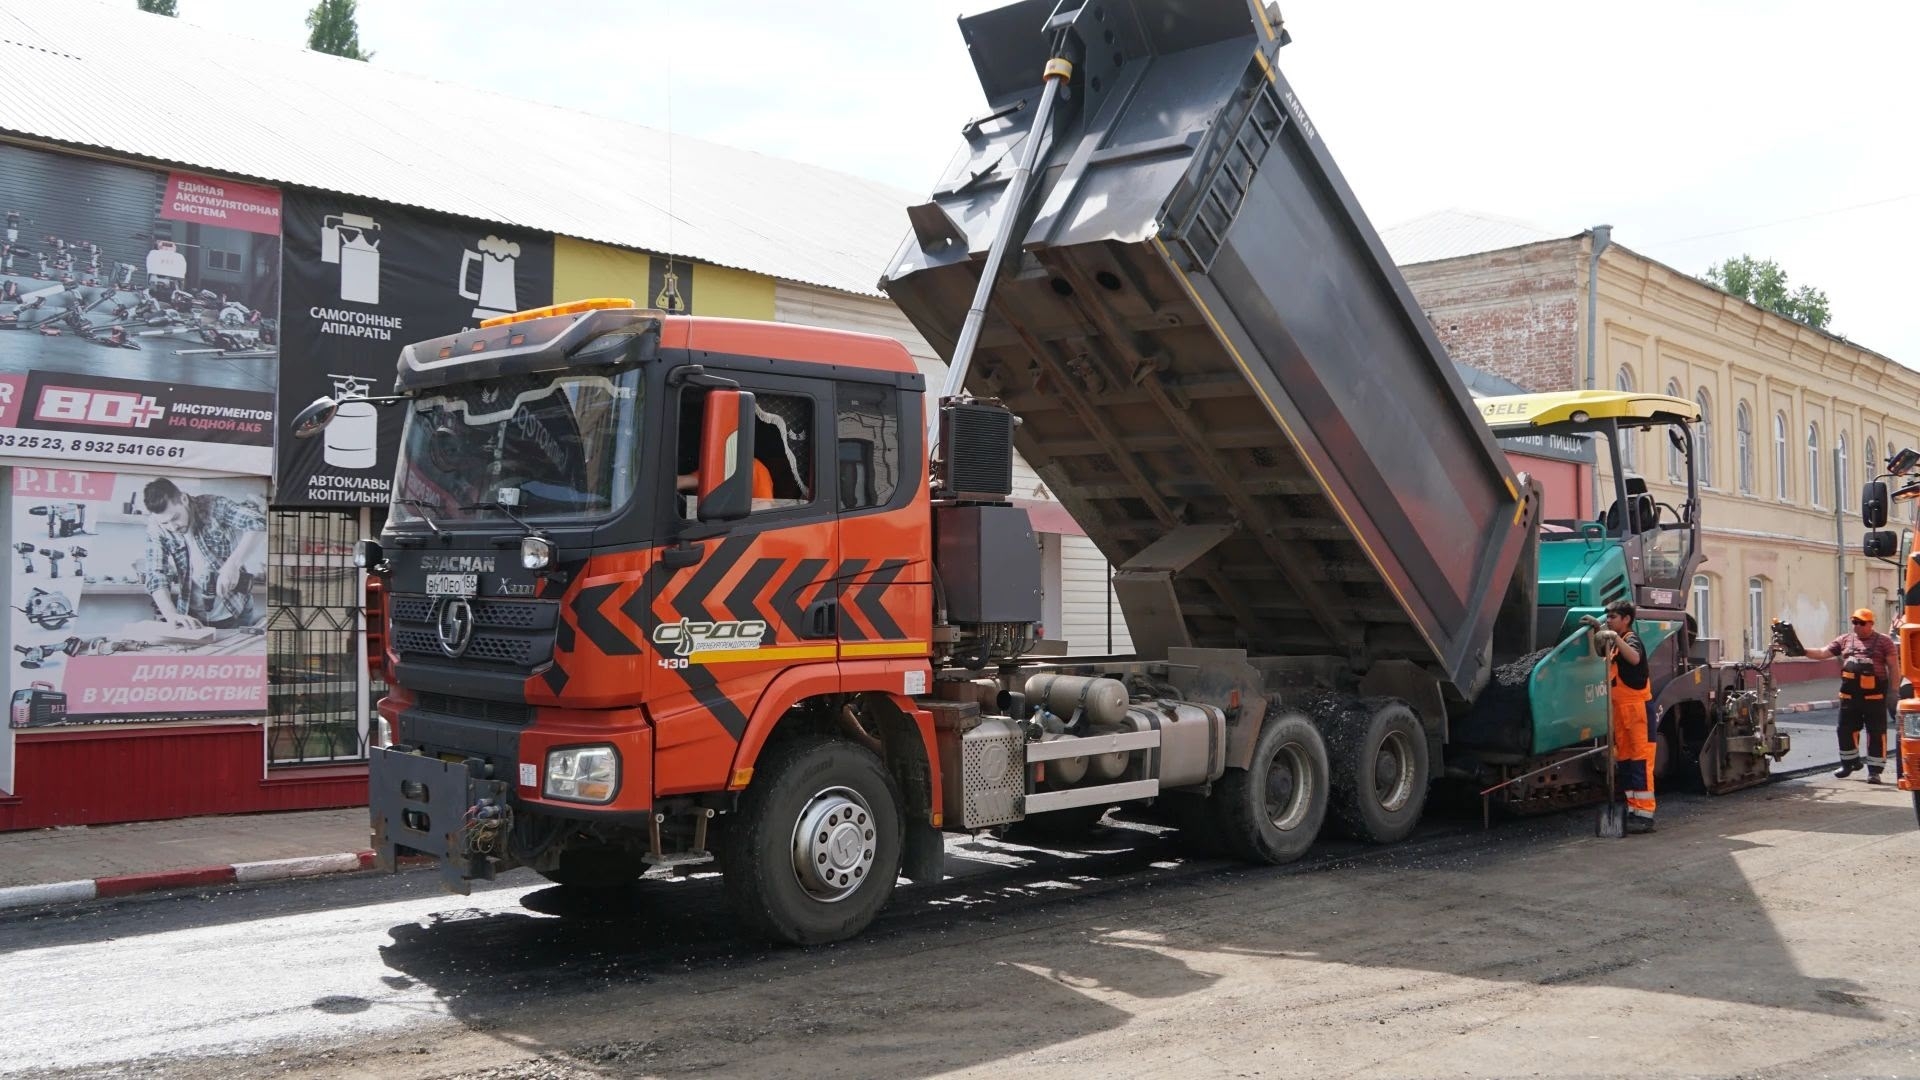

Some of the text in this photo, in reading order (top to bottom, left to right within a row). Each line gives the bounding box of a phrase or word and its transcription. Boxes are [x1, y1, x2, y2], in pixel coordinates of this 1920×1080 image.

[178, 181, 224, 197] ЕДИНАЯ
[173, 202, 227, 219] СИСТЕМА
[176, 191, 279, 217] АККУМУЛЯТОРНАЯ
[310, 306, 402, 329] САМОГОННЫЕ
[321, 321, 391, 341] АППАРАТЫ
[172, 402, 273, 421] ИНСТРУМЕНТОВ
[169, 416, 263, 433] НА ОДНОЙ АКБ
[18, 435, 39, 448] 25
[41, 437, 65, 452] 23,
[71, 439, 82, 451] 8
[85, 440, 114, 454] 932
[116, 443, 143, 456] 541
[146, 445, 165, 457] 66
[168, 446, 185, 458] 61
[1549, 434, 1583, 454] ПИЦЦА
[16, 468, 96, 496] P.I.T.
[308, 474, 390, 490] АВТОКЛАВЫ
[308, 488, 390, 504] КОПТИЛЬНИ
[132, 664, 262, 682] ДЛЯ РАБОТЫ
[658, 658, 688, 669] 430
[82, 685, 262, 705] В УДОВОЛЬСТВИЕ
